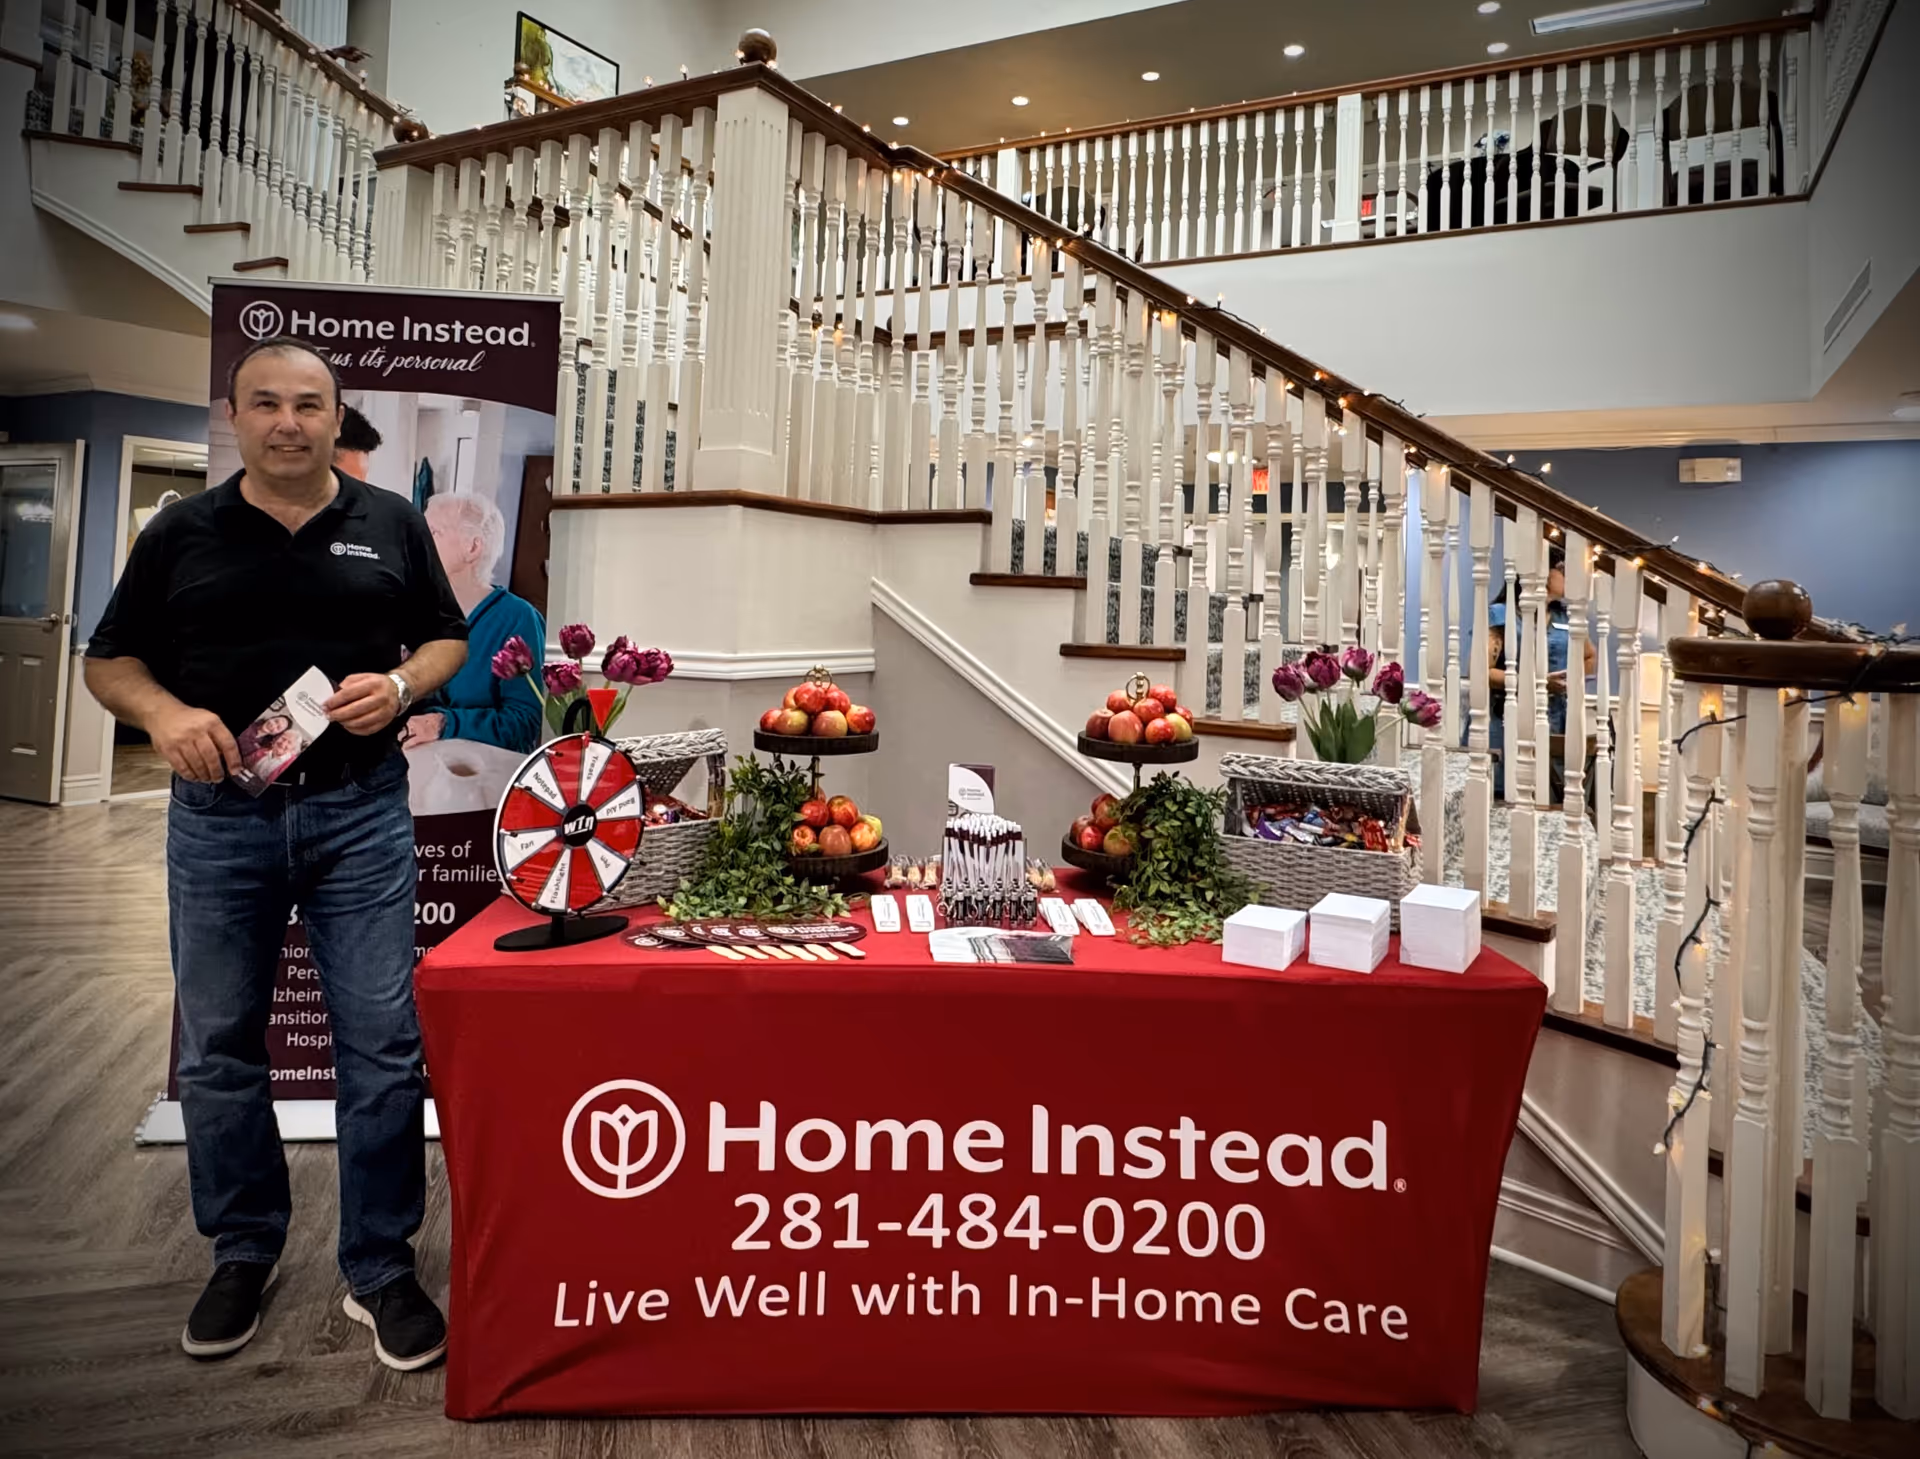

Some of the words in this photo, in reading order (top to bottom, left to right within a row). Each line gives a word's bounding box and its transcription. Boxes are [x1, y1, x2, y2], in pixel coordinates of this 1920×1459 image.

[290, 310, 395, 340] Home
[402, 315, 530, 347] Instead
[329, 351, 353, 367] us,
[359, 345, 387, 368] it's
[381, 350, 487, 377] personal
[346, 542, 373, 552] Home
[532, 772, 558, 800] Notepad
[451, 840, 473, 858] of
[520, 840, 535, 850] Fan
[432, 864, 503, 882] familie
[286, 1031, 333, 1051] Hospi
[707, 1100, 1005, 1174] Home
[1031, 1104, 1387, 1191] Instead
[731, 1192, 1266, 1261] 281-484-0200
[553, 1281, 670, 1327] Live
[694, 1270, 827, 1318] Well
[851, 1270, 981, 1316] with
[1008, 1274, 1261, 1326] In-Home
[1284, 1287, 1410, 1341] Care
